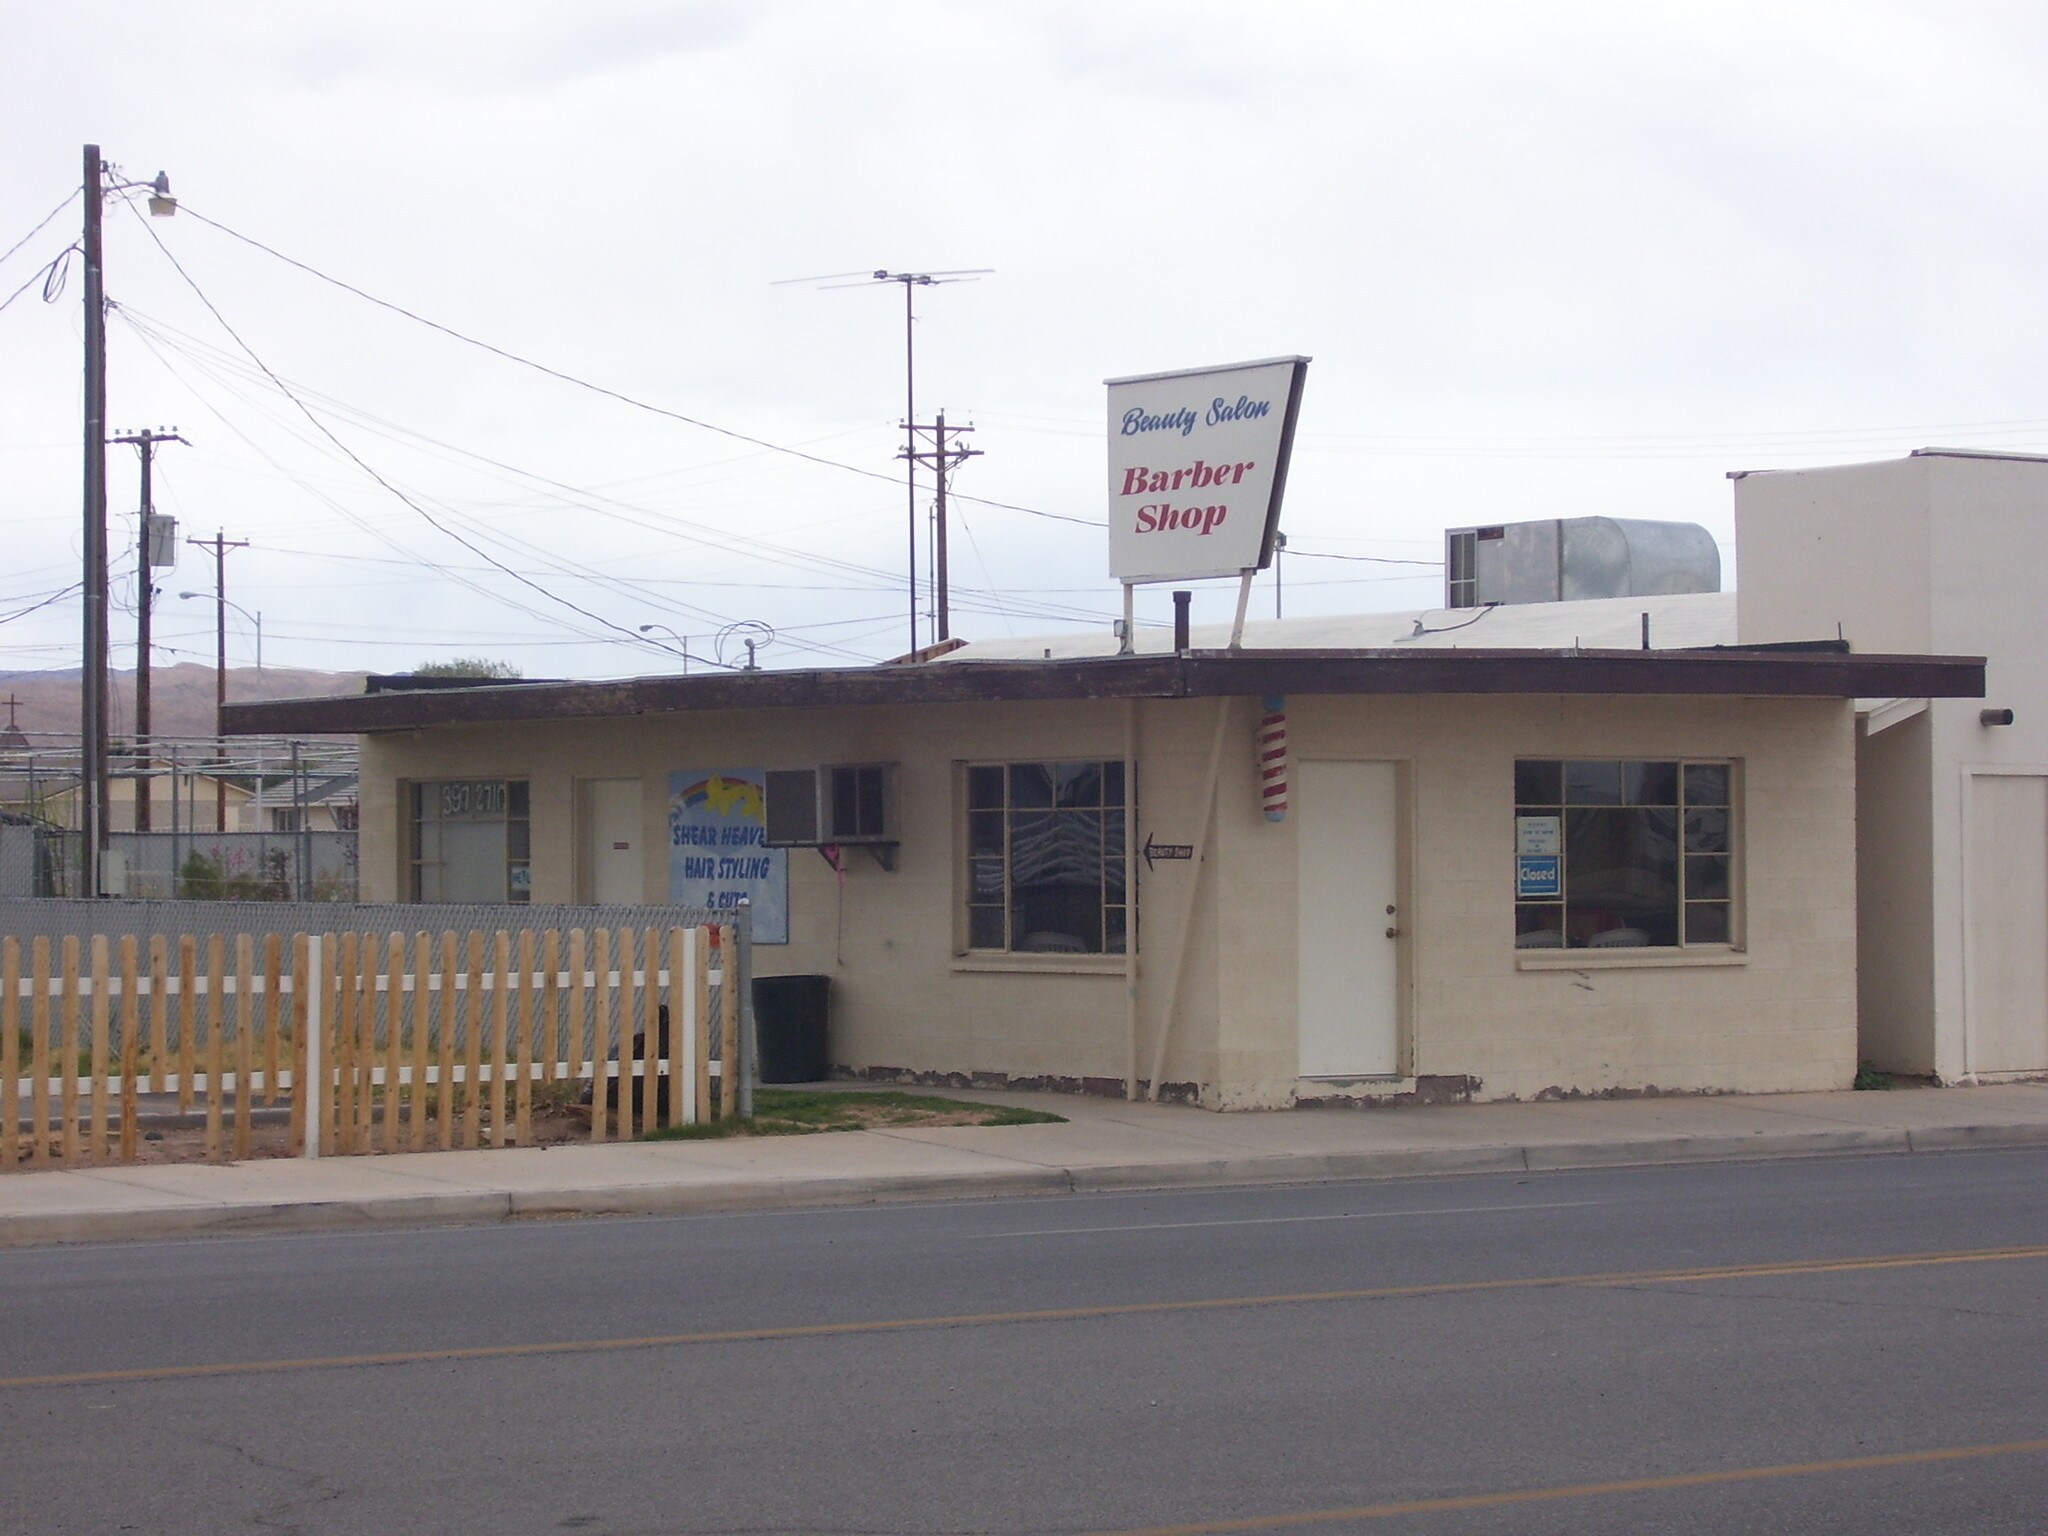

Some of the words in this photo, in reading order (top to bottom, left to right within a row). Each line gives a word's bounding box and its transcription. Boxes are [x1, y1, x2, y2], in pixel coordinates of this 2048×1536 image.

[1121, 407, 1197, 436] Beauty
[1205, 395, 1270, 426] Salon
[1120, 460, 1255, 496] Barber
[1135, 504, 1227, 536] Shop
[673, 824, 717, 846] SHEAR
[721, 825, 765, 846] HEAVE
[685, 857, 714, 880] HAIR
[717, 857, 771, 879] STYLING
[1521, 867, 1556, 881] Closed
[707, 891, 715, 908] &
